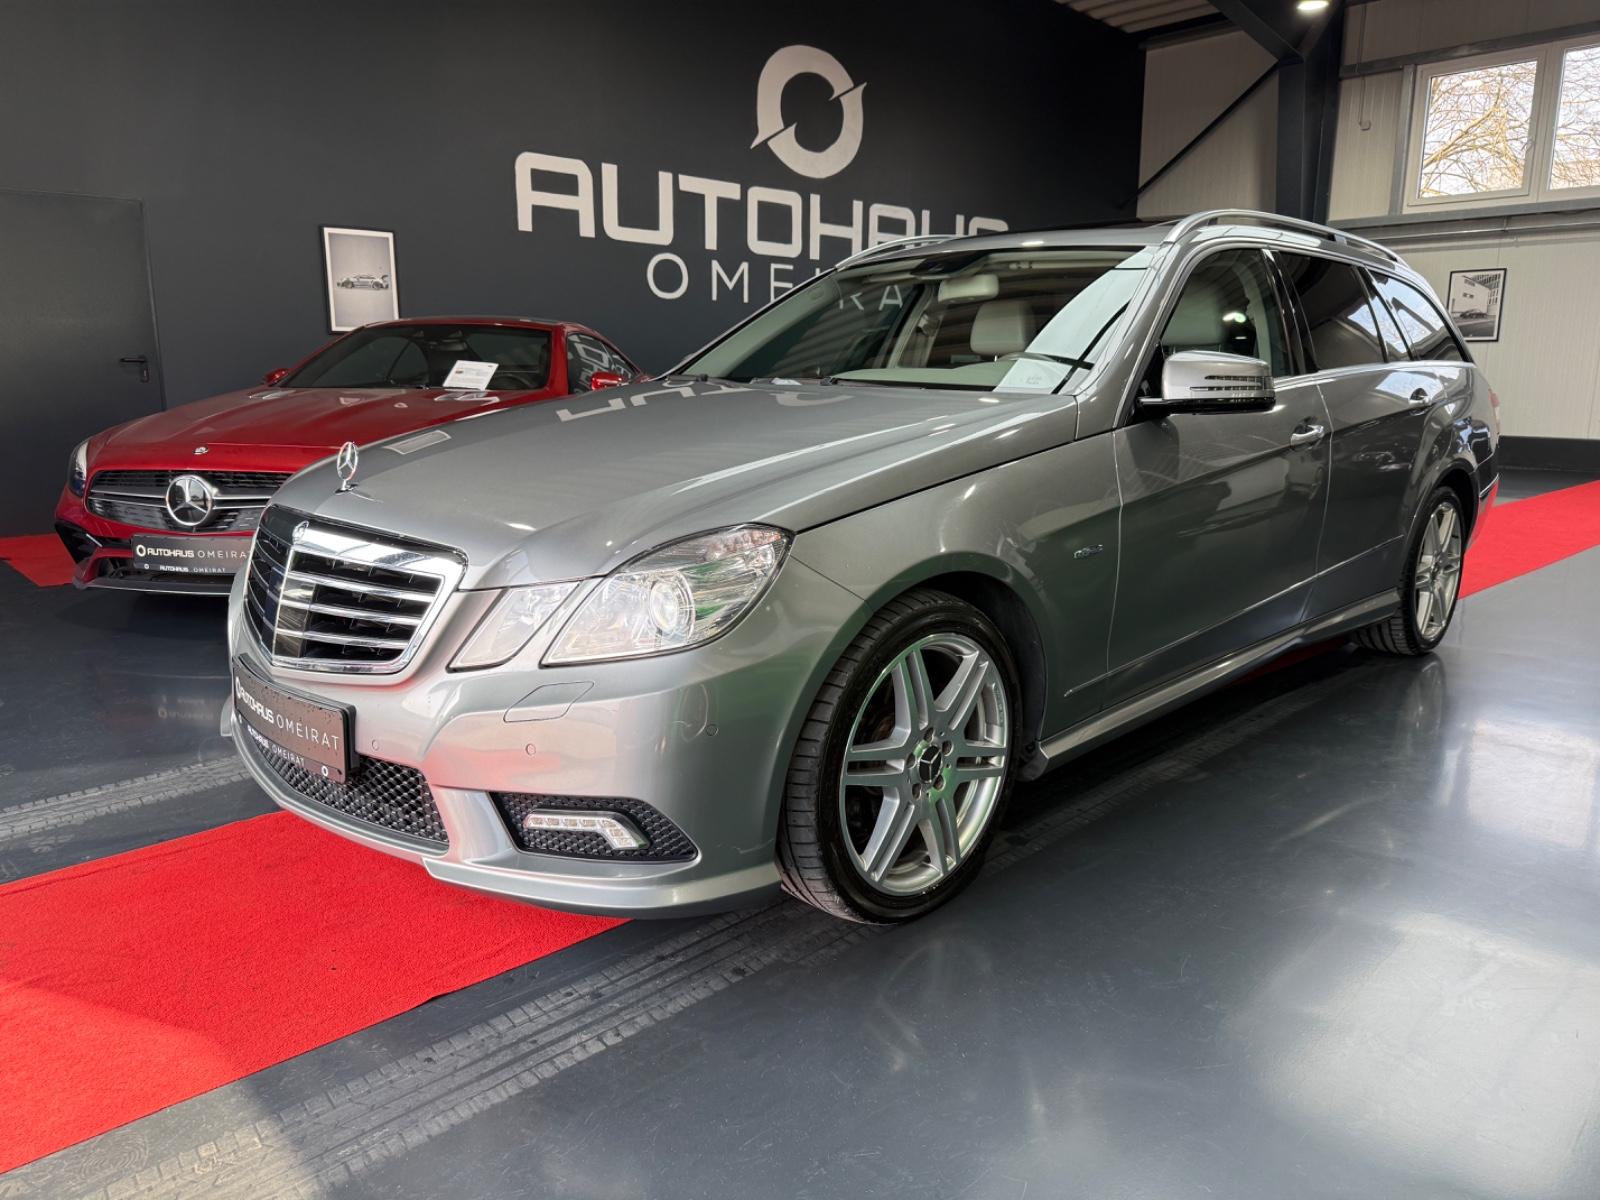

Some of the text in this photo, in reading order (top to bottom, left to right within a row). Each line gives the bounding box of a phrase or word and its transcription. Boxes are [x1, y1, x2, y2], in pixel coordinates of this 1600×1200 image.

[147, 548, 251, 559] AUTOHAUS OMEIRA
[239, 686, 275, 724] AUTOHAUS
[276, 713, 340, 751] OMEIRAT
